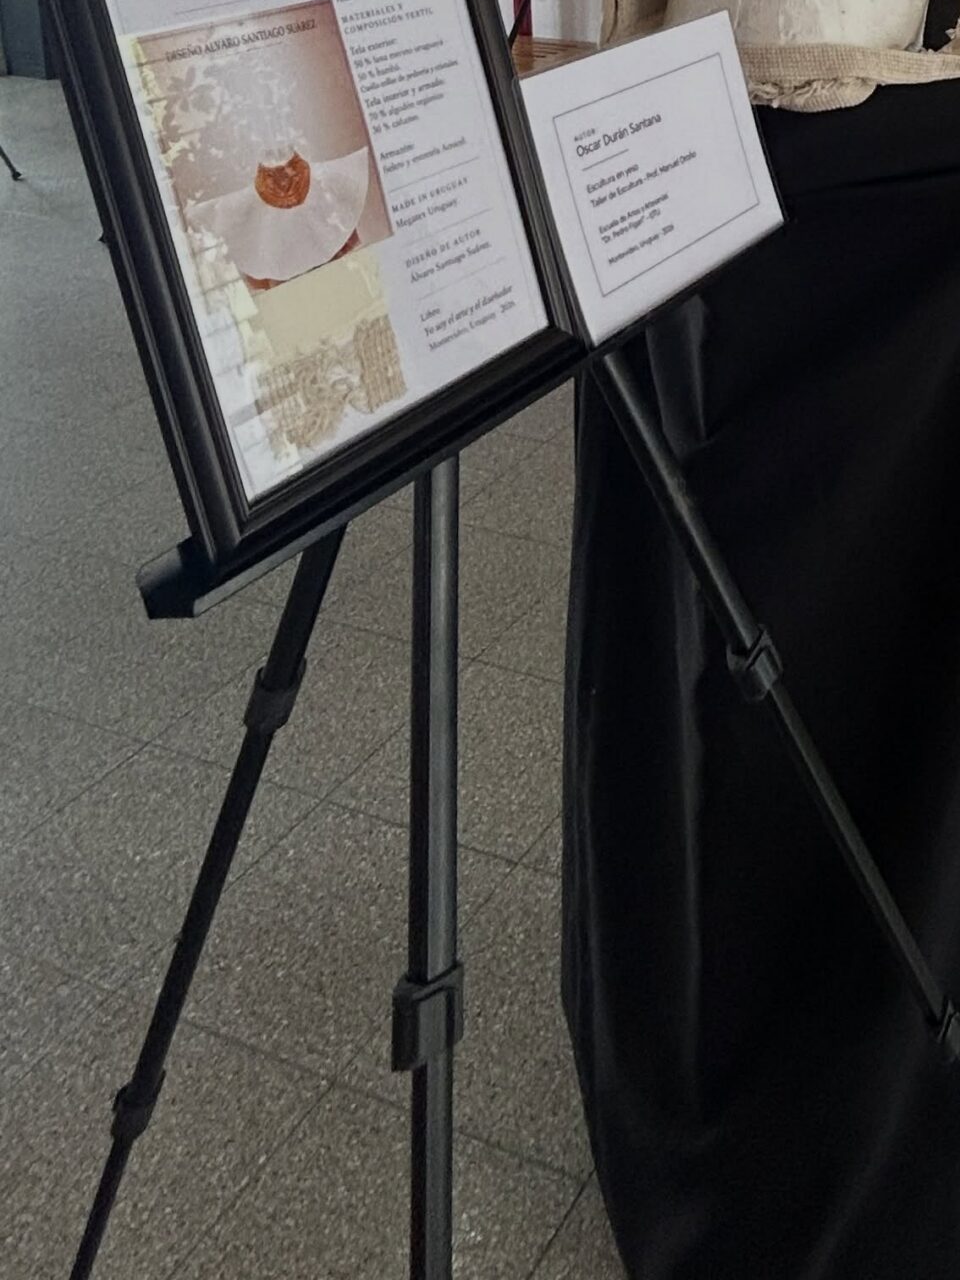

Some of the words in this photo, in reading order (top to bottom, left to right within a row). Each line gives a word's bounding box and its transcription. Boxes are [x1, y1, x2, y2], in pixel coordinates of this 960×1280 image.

[341, 5, 396, 24] MATERIALES
[344, 15, 404, 35] COMPOSICIÓN
[404, 7, 434, 20] TEXTIL
[240, 26, 286, 45] SANTIAGO
[576, 139, 602, 158] Oscar
[602, 126, 630, 147] Durán
[629, 113, 662, 135] Santana
[391, 198, 416, 214] MADE
[429, 177, 469, 199] URUGUAY
[586, 176, 616, 195] Escultura
[405, 247, 438, 269] DISEÑO
[453, 228, 481, 247] AUTOR
